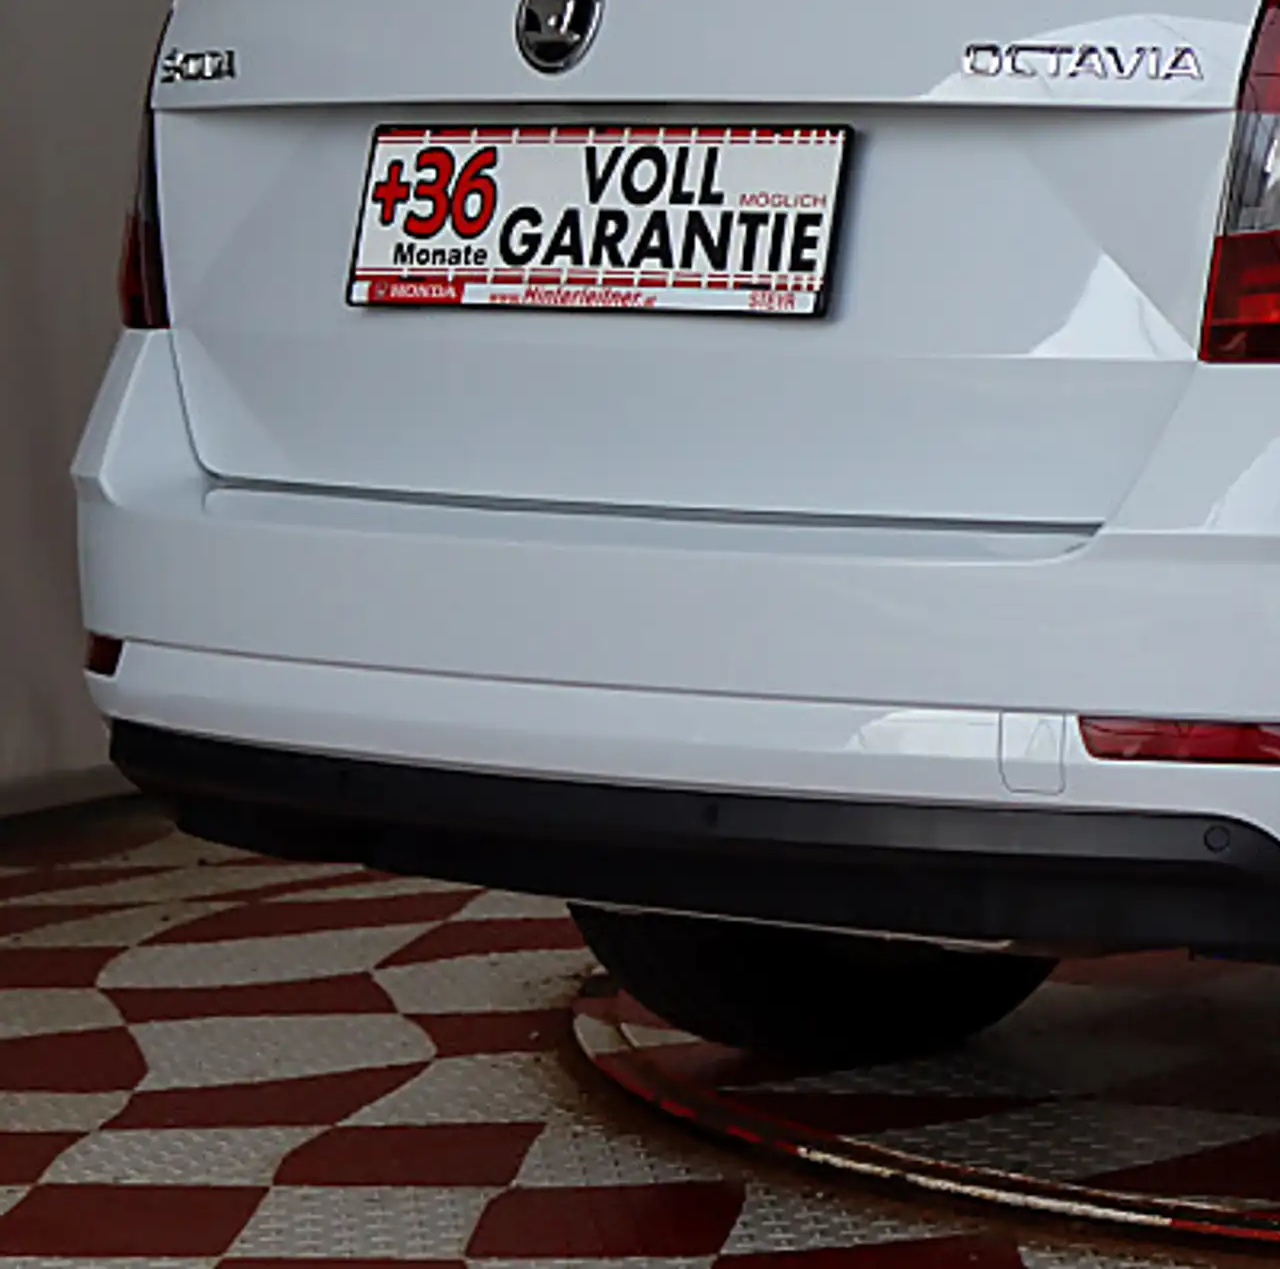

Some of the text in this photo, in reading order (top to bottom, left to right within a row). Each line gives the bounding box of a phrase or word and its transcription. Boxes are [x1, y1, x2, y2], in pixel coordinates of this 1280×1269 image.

[962, 43, 1205, 81] OCTAVIA
[373, 147, 497, 239] +36
[585, 146, 724, 204] VOLL
[394, 243, 487, 266] Monate
[500, 207, 822, 271] GARANTIE
[389, 282, 456, 299] HONDA
